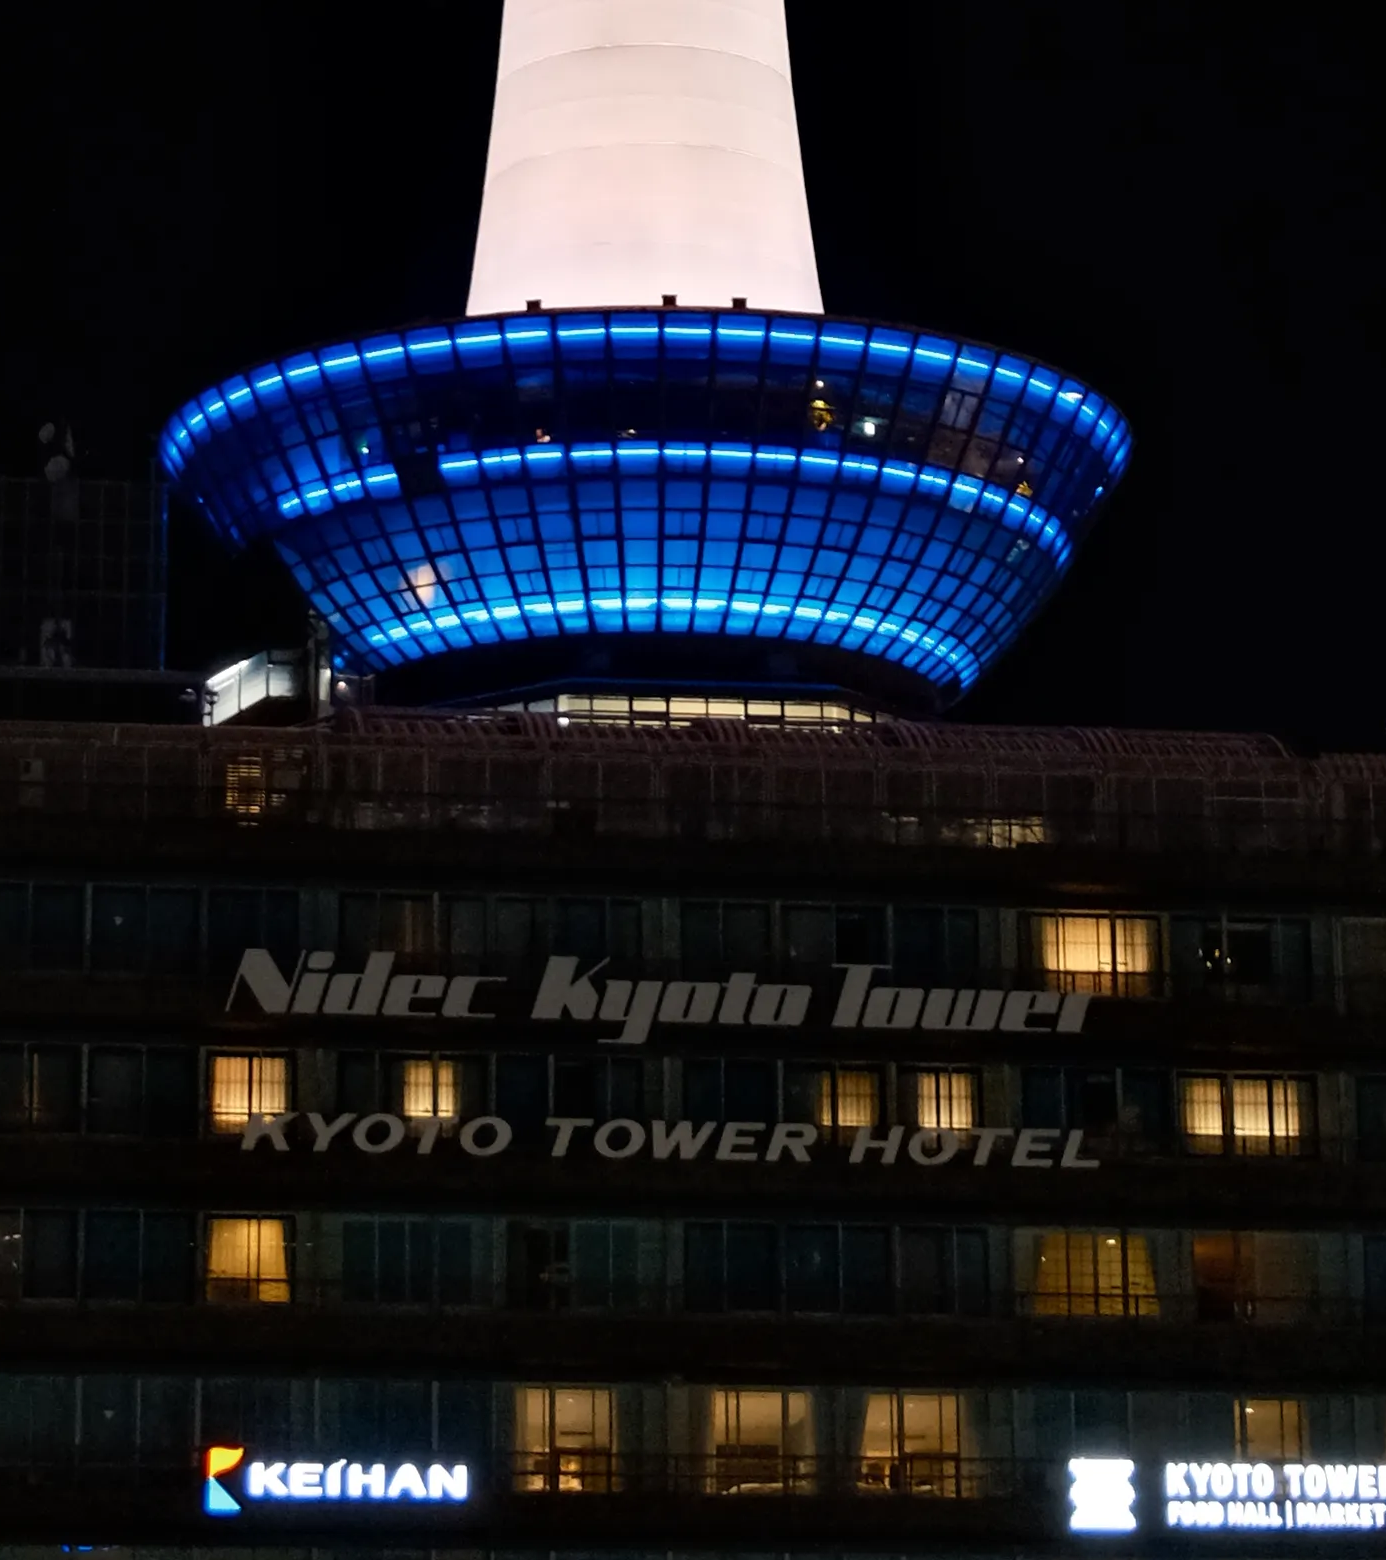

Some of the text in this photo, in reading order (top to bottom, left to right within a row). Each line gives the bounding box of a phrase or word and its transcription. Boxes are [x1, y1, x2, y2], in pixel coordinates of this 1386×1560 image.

[225, 947, 1094, 1044] Nidec Kyoto Tower
[240, 1111, 1101, 1169] KYOTO TOWER HOTEL
[246, 1458, 469, 1501] KEIHAN
[1165, 1462, 1275, 1500] KYOTO
[1167, 1500, 1225, 1527] FOOD
[1227, 1501, 1283, 1527] HALL
